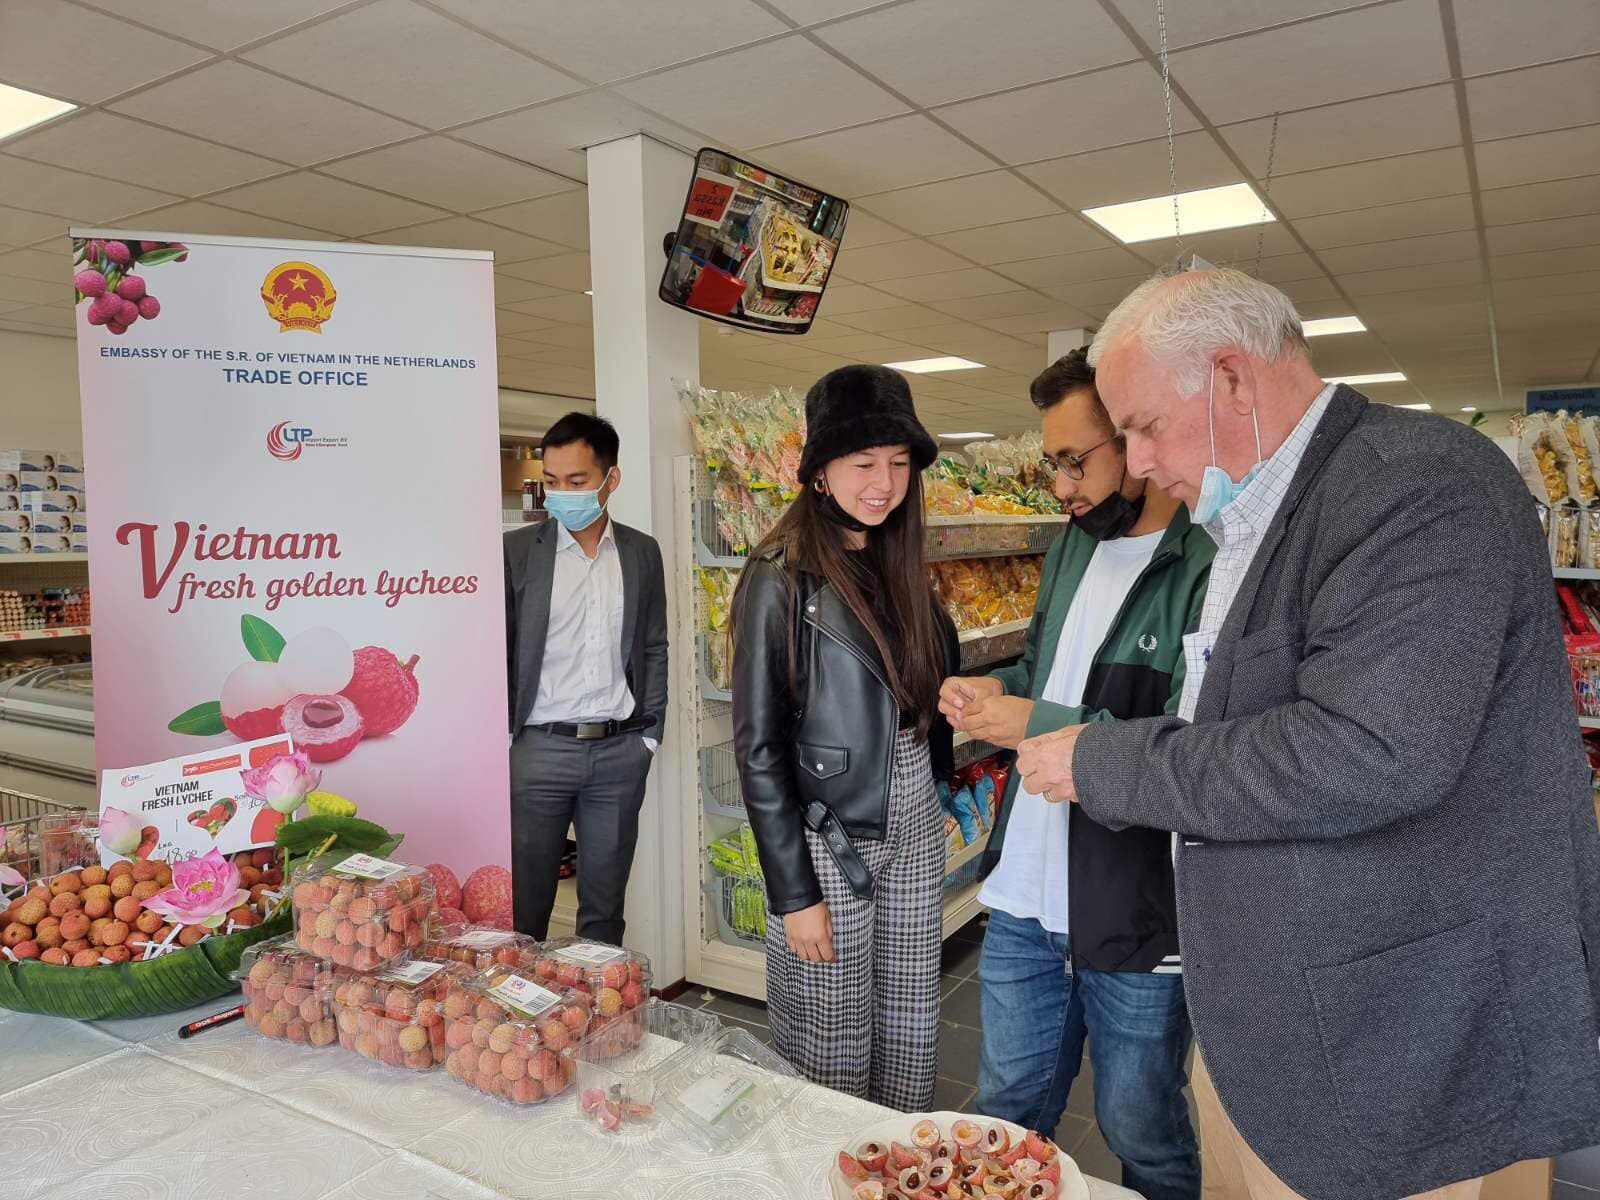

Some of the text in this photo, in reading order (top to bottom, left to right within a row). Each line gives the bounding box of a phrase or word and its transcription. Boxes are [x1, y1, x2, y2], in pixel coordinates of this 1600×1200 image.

[100, 346, 476, 369] EMBASSY OF THE S.R. OF VIETNAM IN THE NETHERLANDS
[222, 368, 368, 386] TRADE OFFICE
[283, 427, 313, 442] LTP
[115, 520, 341, 599] Vietnam
[168, 569, 479, 614] fresh golden lychees
[155, 780, 199, 797] VIETNAM
[141, 789, 214, 811] FRESH LYCHEE
